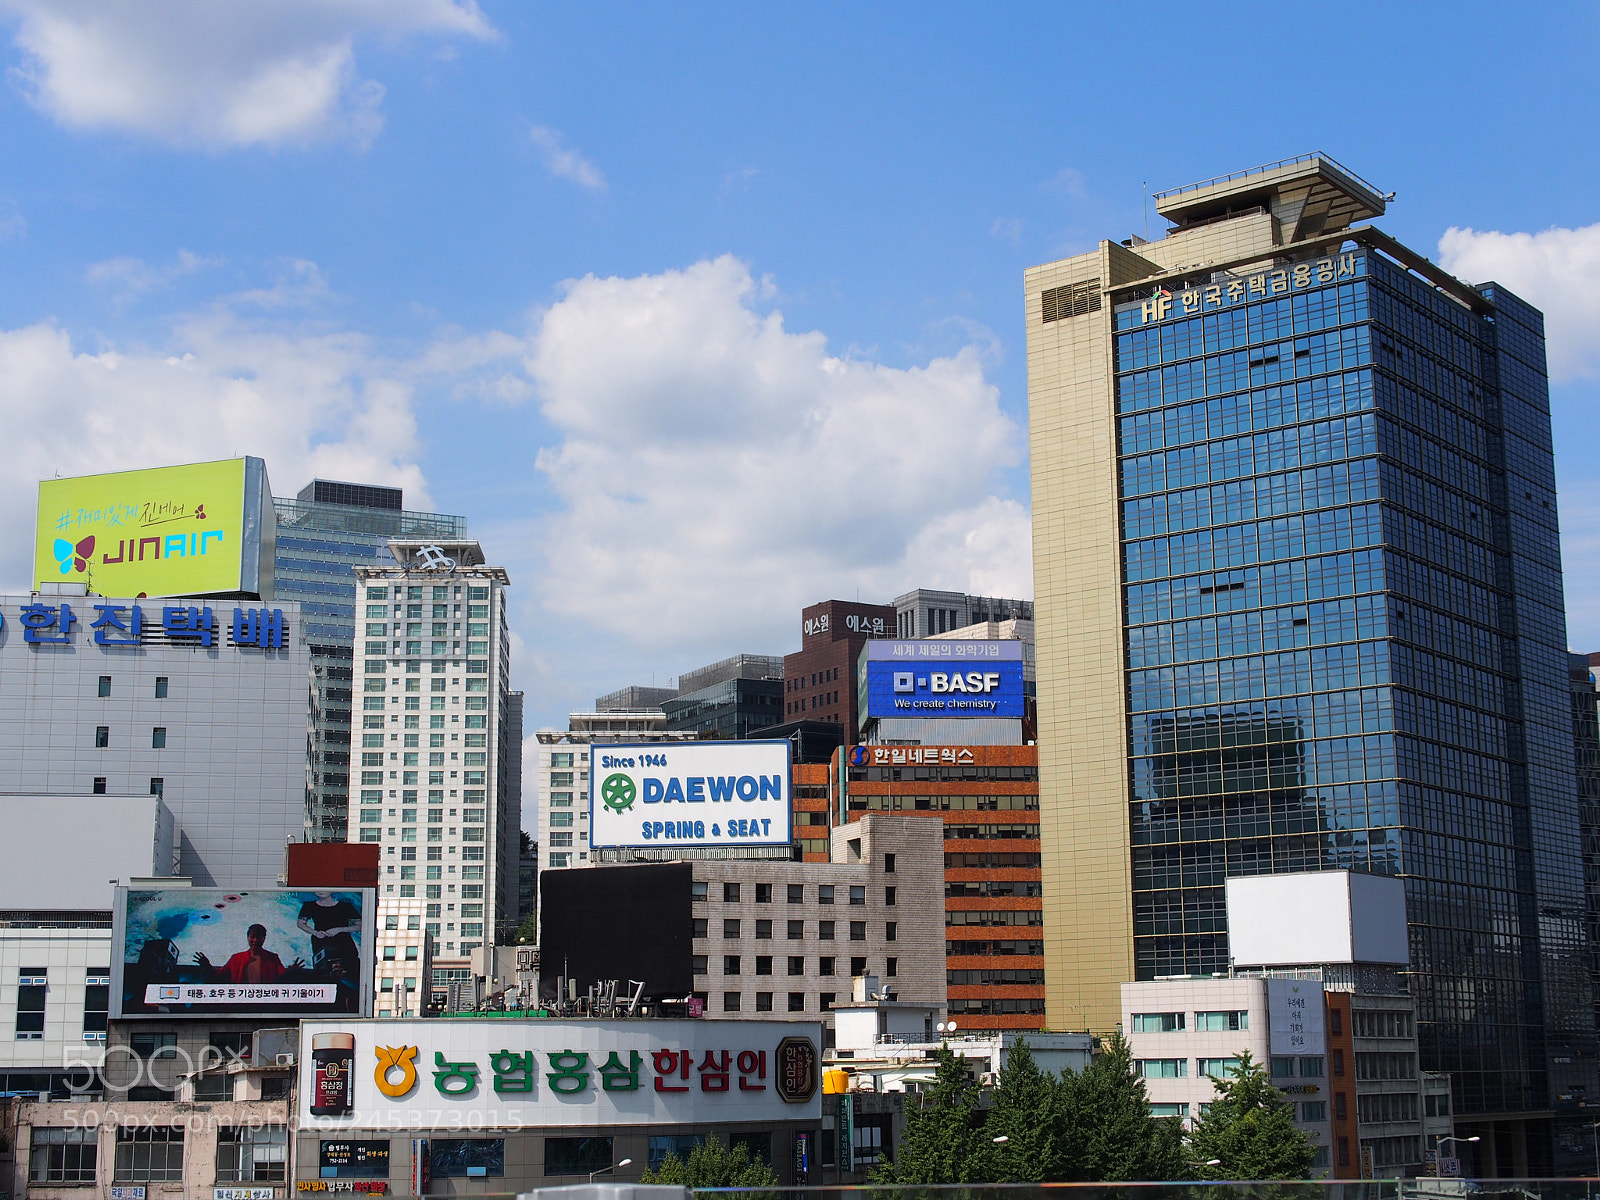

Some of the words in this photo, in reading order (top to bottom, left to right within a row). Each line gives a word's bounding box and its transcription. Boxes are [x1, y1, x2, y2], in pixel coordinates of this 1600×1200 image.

[1182, 253, 1357, 313] 한국주택금융공사
[1141, 293, 1172, 323] HF
[20, 603, 283, 648] 한진택배
[804, 613, 829, 636] 에스원
[845, 614, 884, 634] 에스원
[892, 644, 915, 657] 세계
[919, 643, 952, 657] 제일의
[955, 643, 1000, 657] 화학기업
[930, 671, 1000, 694] BASF
[895, 698, 911, 708] We
[913, 699, 945, 709] create
[947, 698, 998, 711] chemistry
[602, 755, 635, 768] Since
[638, 753, 668, 767] 1946
[874, 748, 975, 765] 한일네트웍스
[643, 774, 782, 803] DAEWON
[641, 820, 705, 839] SPRING
[711, 823, 721, 837] &
[727, 818, 772, 837] SEAT
[209, 989, 226, 998] 호우
[228, 988, 236, 998] 등
[238, 988, 279, 999] 기상정보에
[281, 988, 291, 999] 귀
[431, 1048, 643, 1095] 농협홍삼
[651, 1048, 767, 1093] 한삼인
[786, 1046, 797, 1093] 한삼인
[320, 1081, 344, 1090] 홍삼정
[327, 1181, 354, 1193] 법무사
